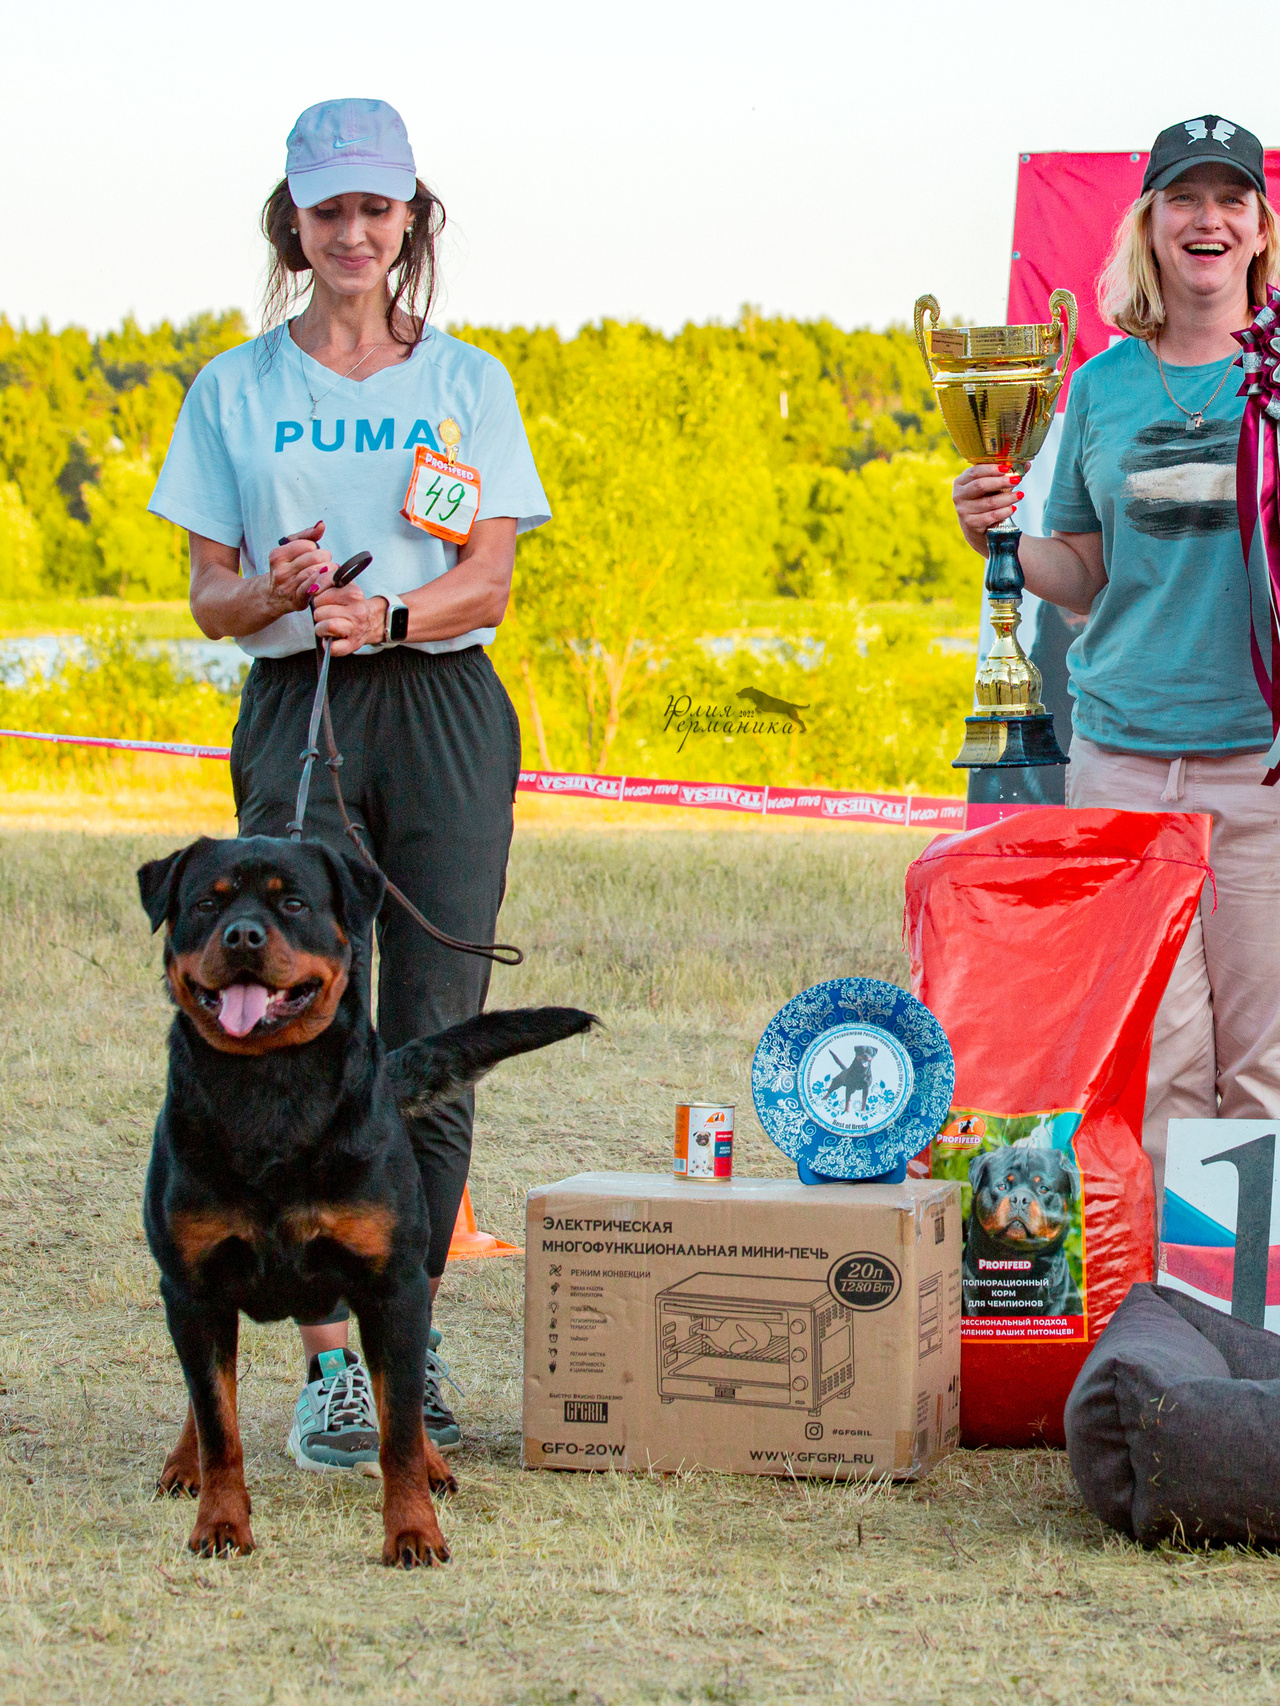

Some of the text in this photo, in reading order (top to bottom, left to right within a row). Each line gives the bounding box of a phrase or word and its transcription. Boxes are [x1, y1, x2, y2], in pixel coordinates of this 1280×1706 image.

[274, 417, 441, 453] PUMA
[426, 475, 466, 521] 49
[539, 775, 619, 796] ТРАПЕЗА
[681, 786, 763, 808] ТРАПЕЗА
[825, 799, 905, 819] ТРАПЕЗА
[936, 1133, 982, 1146] PROFIFEED
[543, 1216, 673, 1234] ЭЛЕКТРИЧЕСКАЯ
[1200, 1133, 1277, 1330] 1
[542, 1240, 829, 1259] МНОГОФУНКЦИОНАЛЬНАЯ МИНИ-ПЕЧЬ
[978, 1259, 1032, 1270] PROFIFEED
[570, 1269, 651, 1279] РЕЖИМ КОНВЕКЦИИ
[840, 1282, 872, 1292] 1280
[962, 1278, 1049, 1288] ПОЛНОРАЦИОННЫЙ
[968, 1300, 986, 1308] ДЛЯ
[961, 1318, 1031, 1326] ФЕССИОНАЛЬНЫЙ
[1027, 1329, 1074, 1337] ПИТОМЦЕВ!
[832, 1428, 873, 1437] #GFGRIL
[541, 1442, 626, 1456] GFO-20W
[749, 1450, 874, 1464] WWW.GFGRIL.RU
